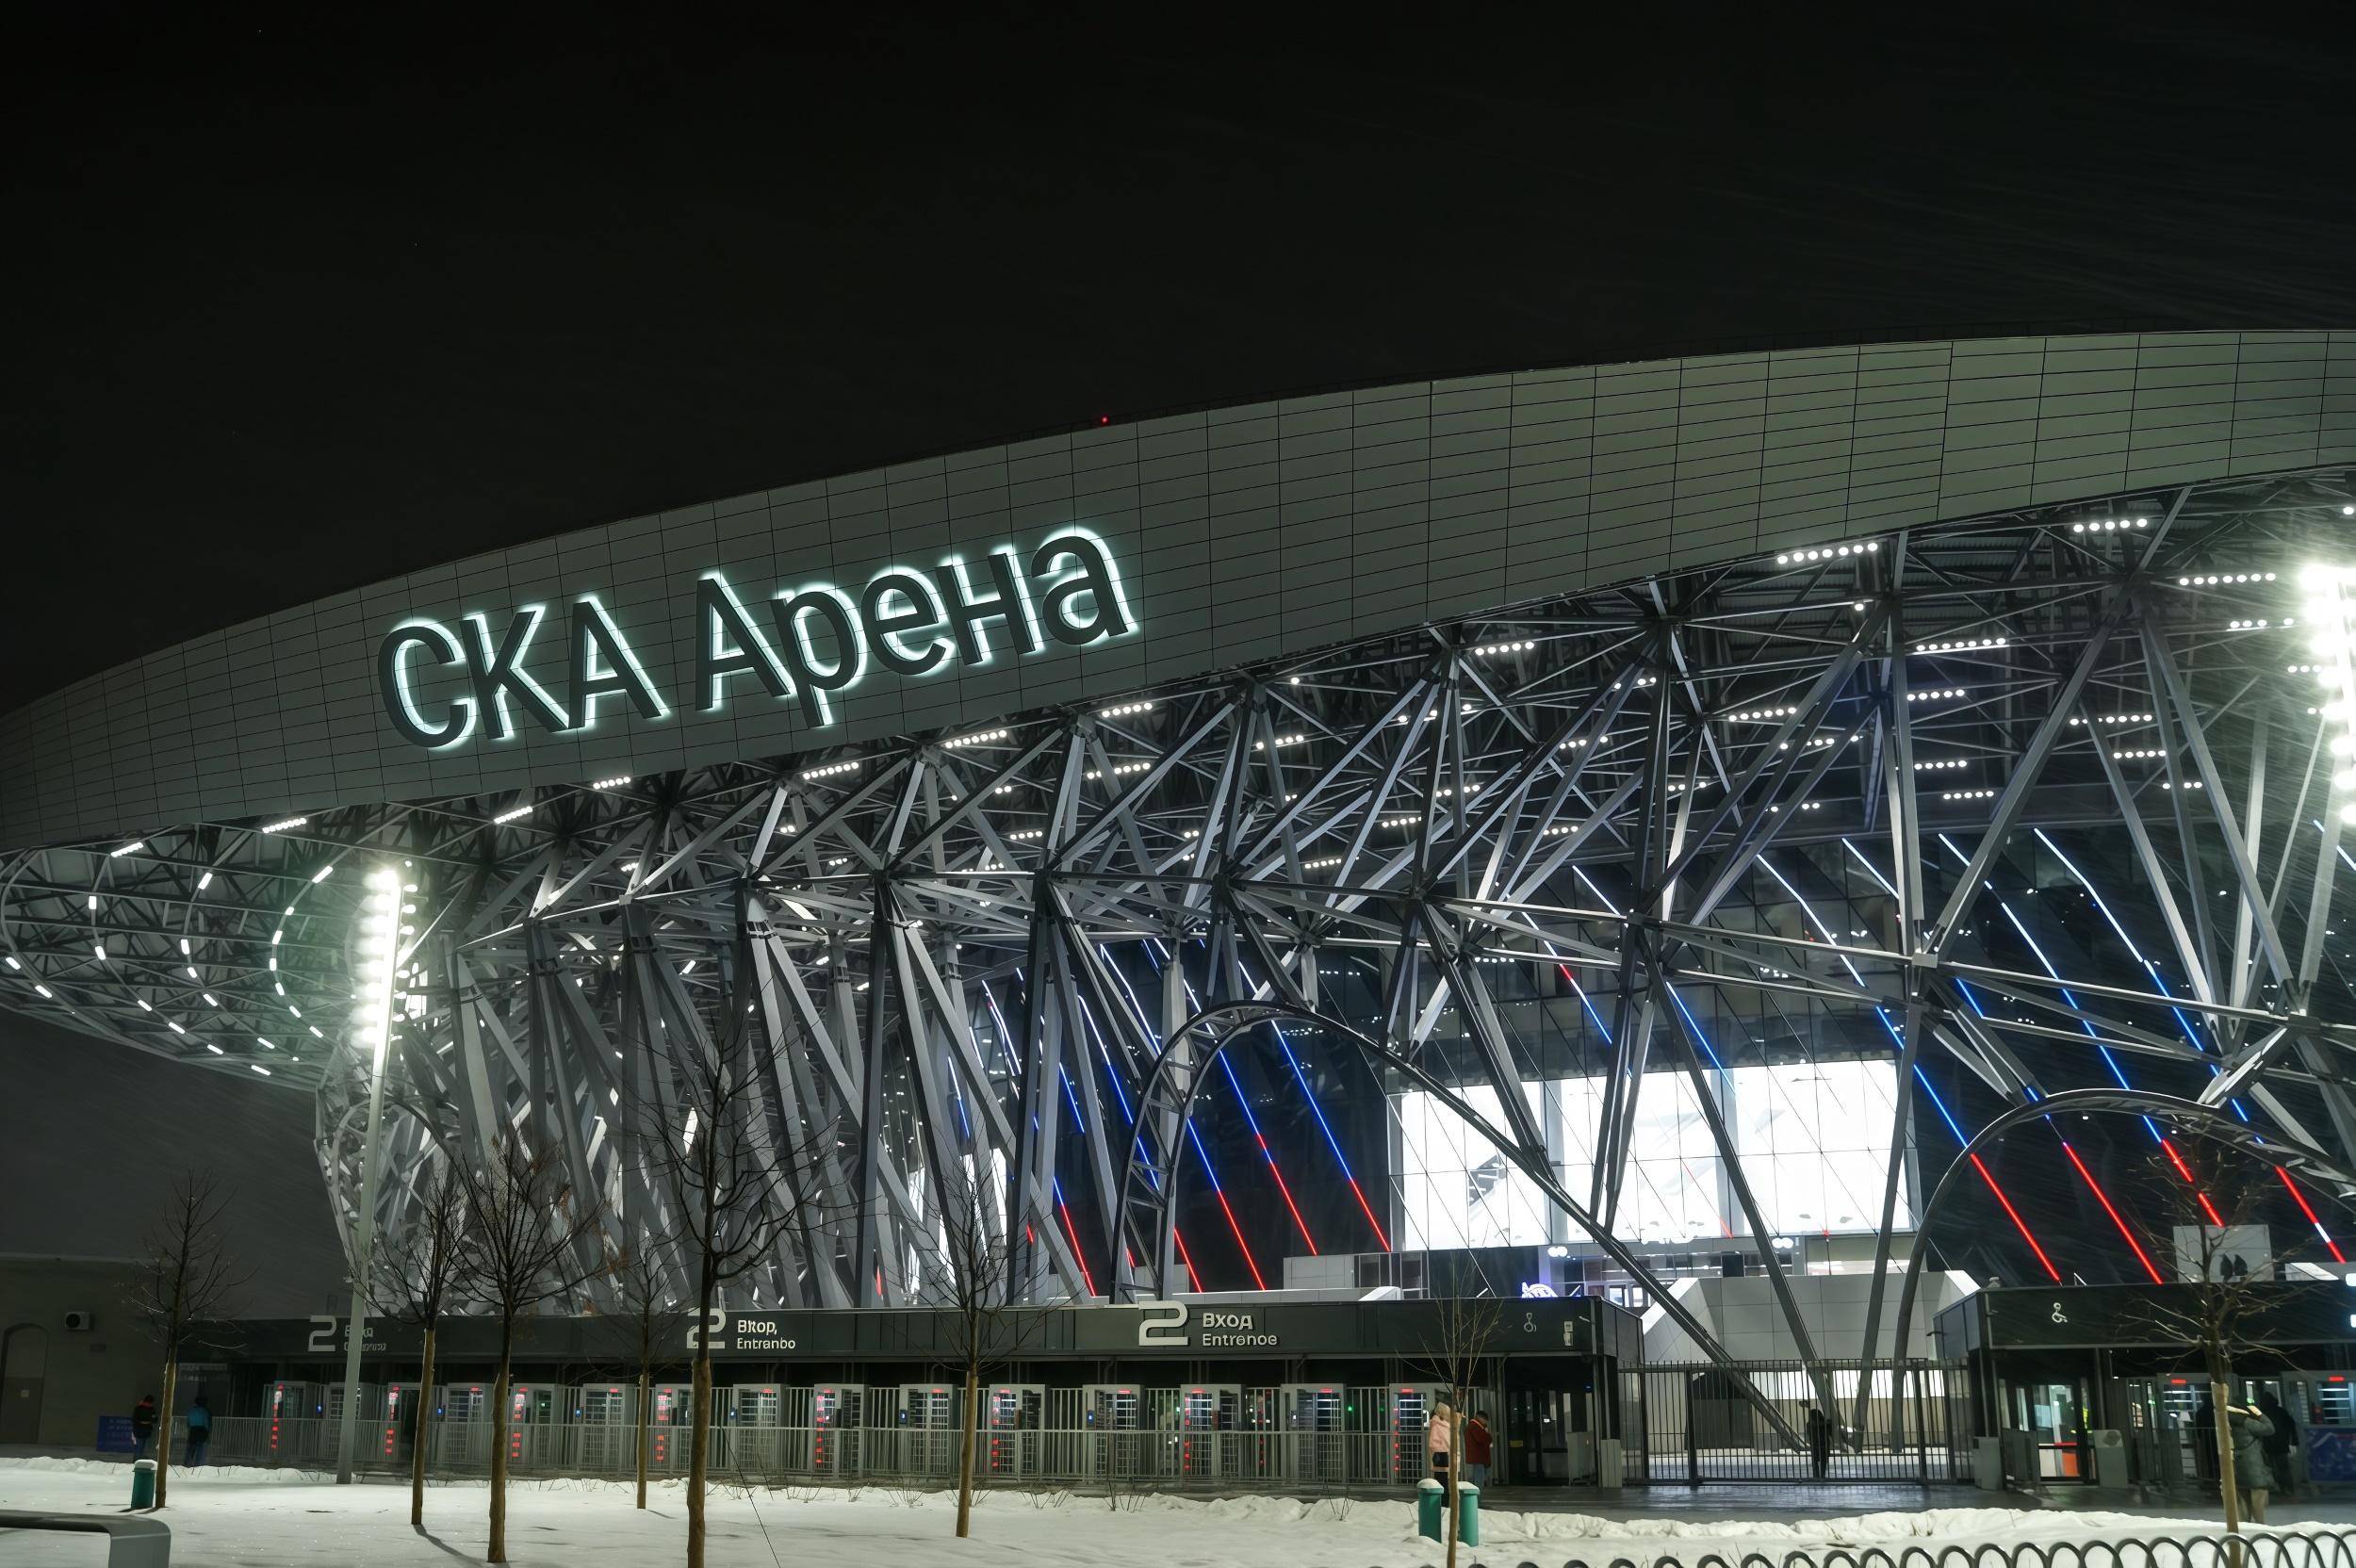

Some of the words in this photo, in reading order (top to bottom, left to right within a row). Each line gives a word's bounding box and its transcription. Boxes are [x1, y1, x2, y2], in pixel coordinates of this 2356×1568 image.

[377, 594, 670, 748] СКА
[695, 525, 1141, 728] Арена
[308, 1315, 337, 1351] 2
[686, 1308, 727, 1349] 2
[1138, 1300, 1188, 1346] 2
